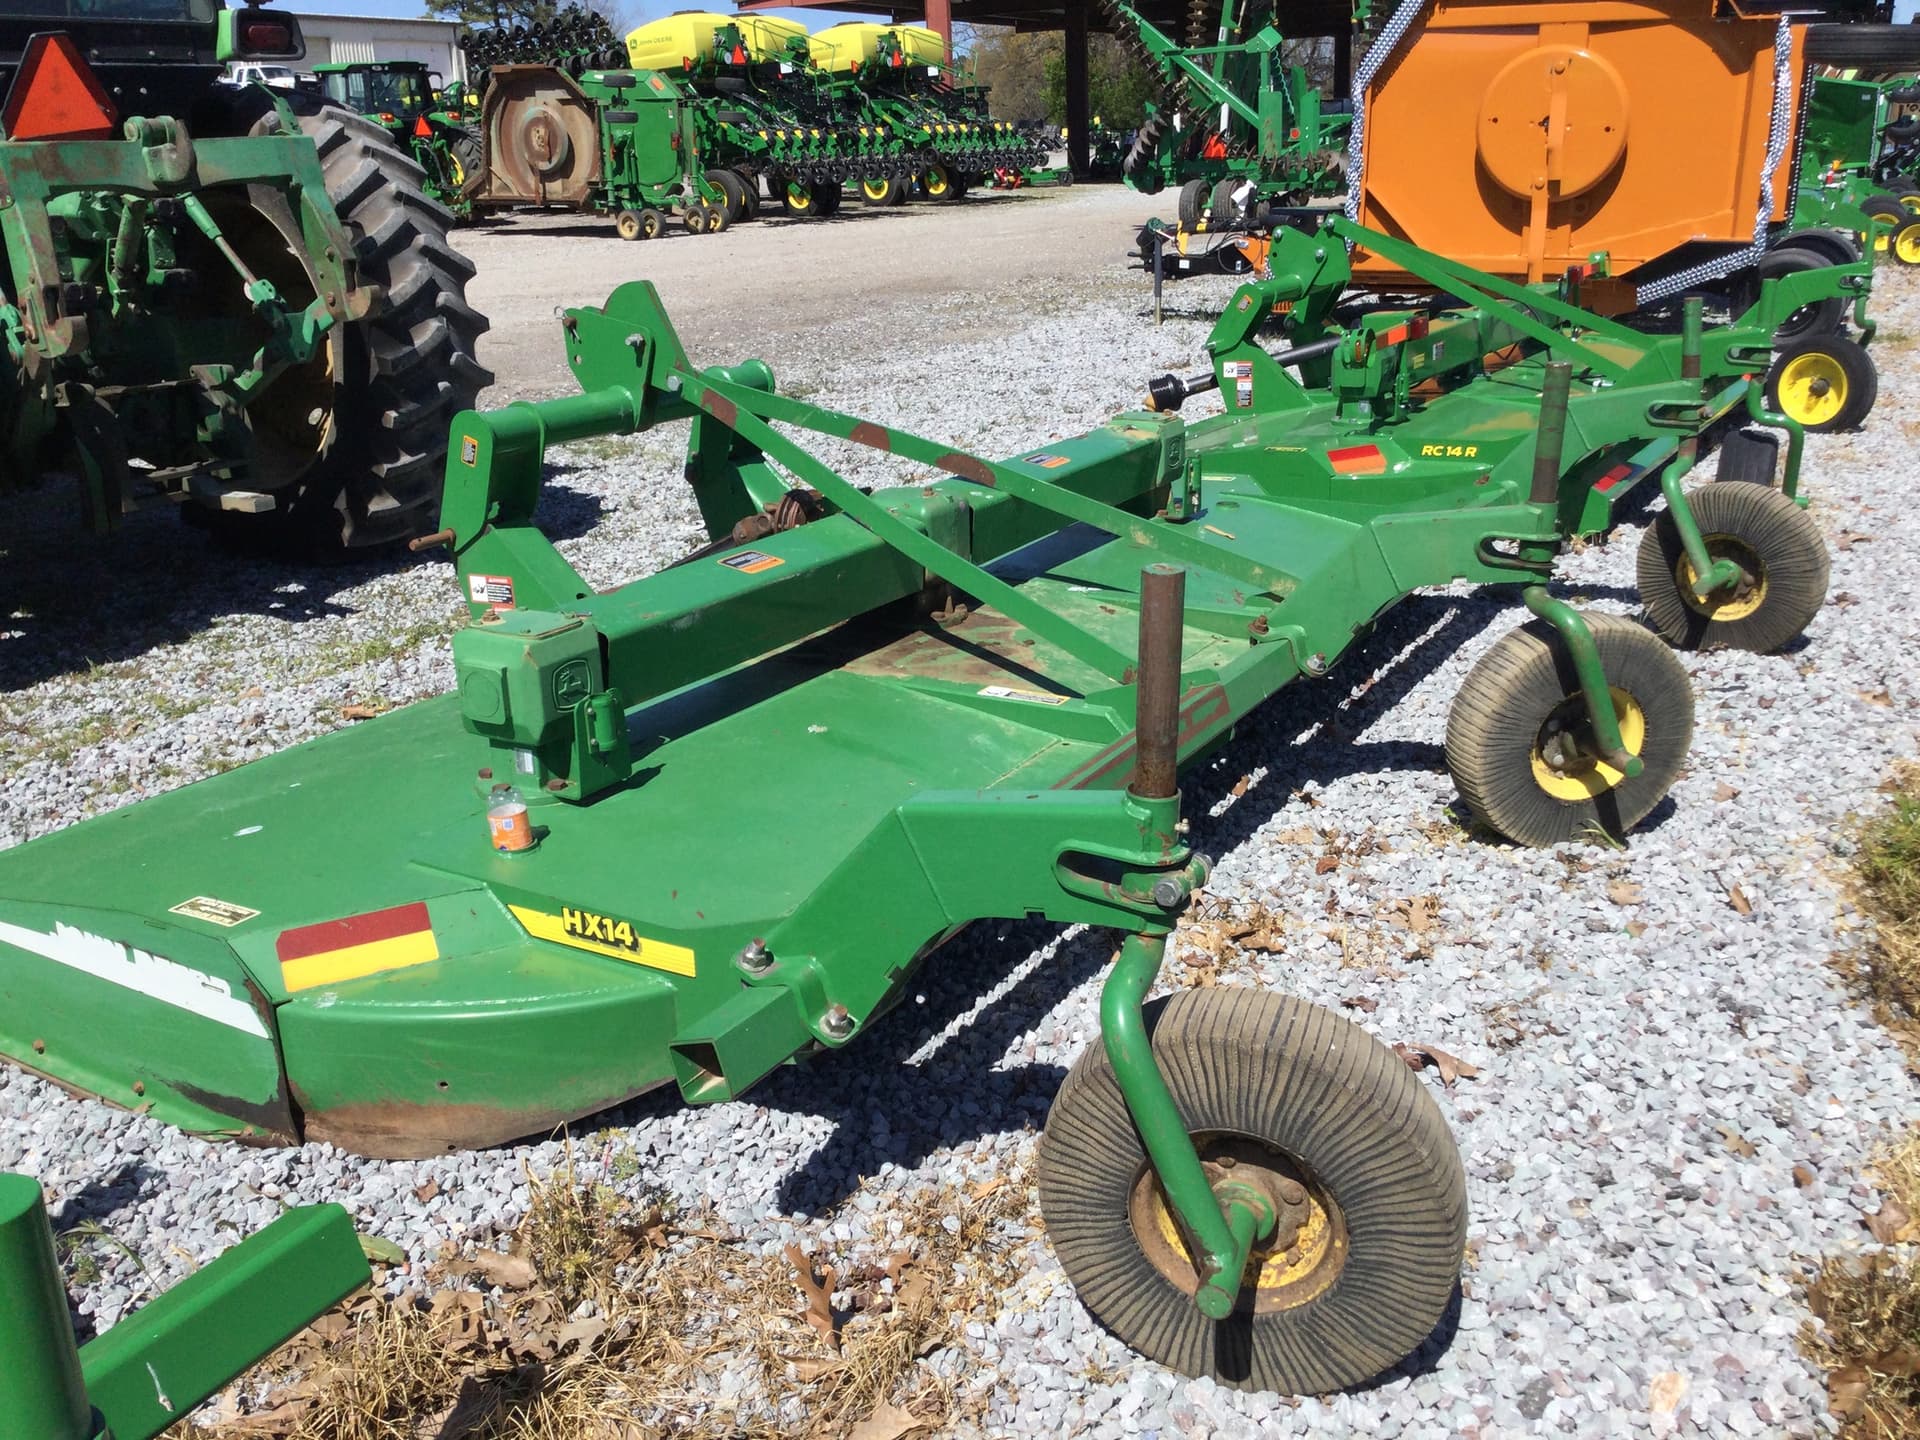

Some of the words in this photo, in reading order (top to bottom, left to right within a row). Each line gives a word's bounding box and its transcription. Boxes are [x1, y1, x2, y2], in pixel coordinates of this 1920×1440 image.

[1421, 445, 1444, 456] RC
[1446, 445, 1462, 457] 14
[1464, 446, 1477, 458] R
[561, 906, 638, 950] HX14
